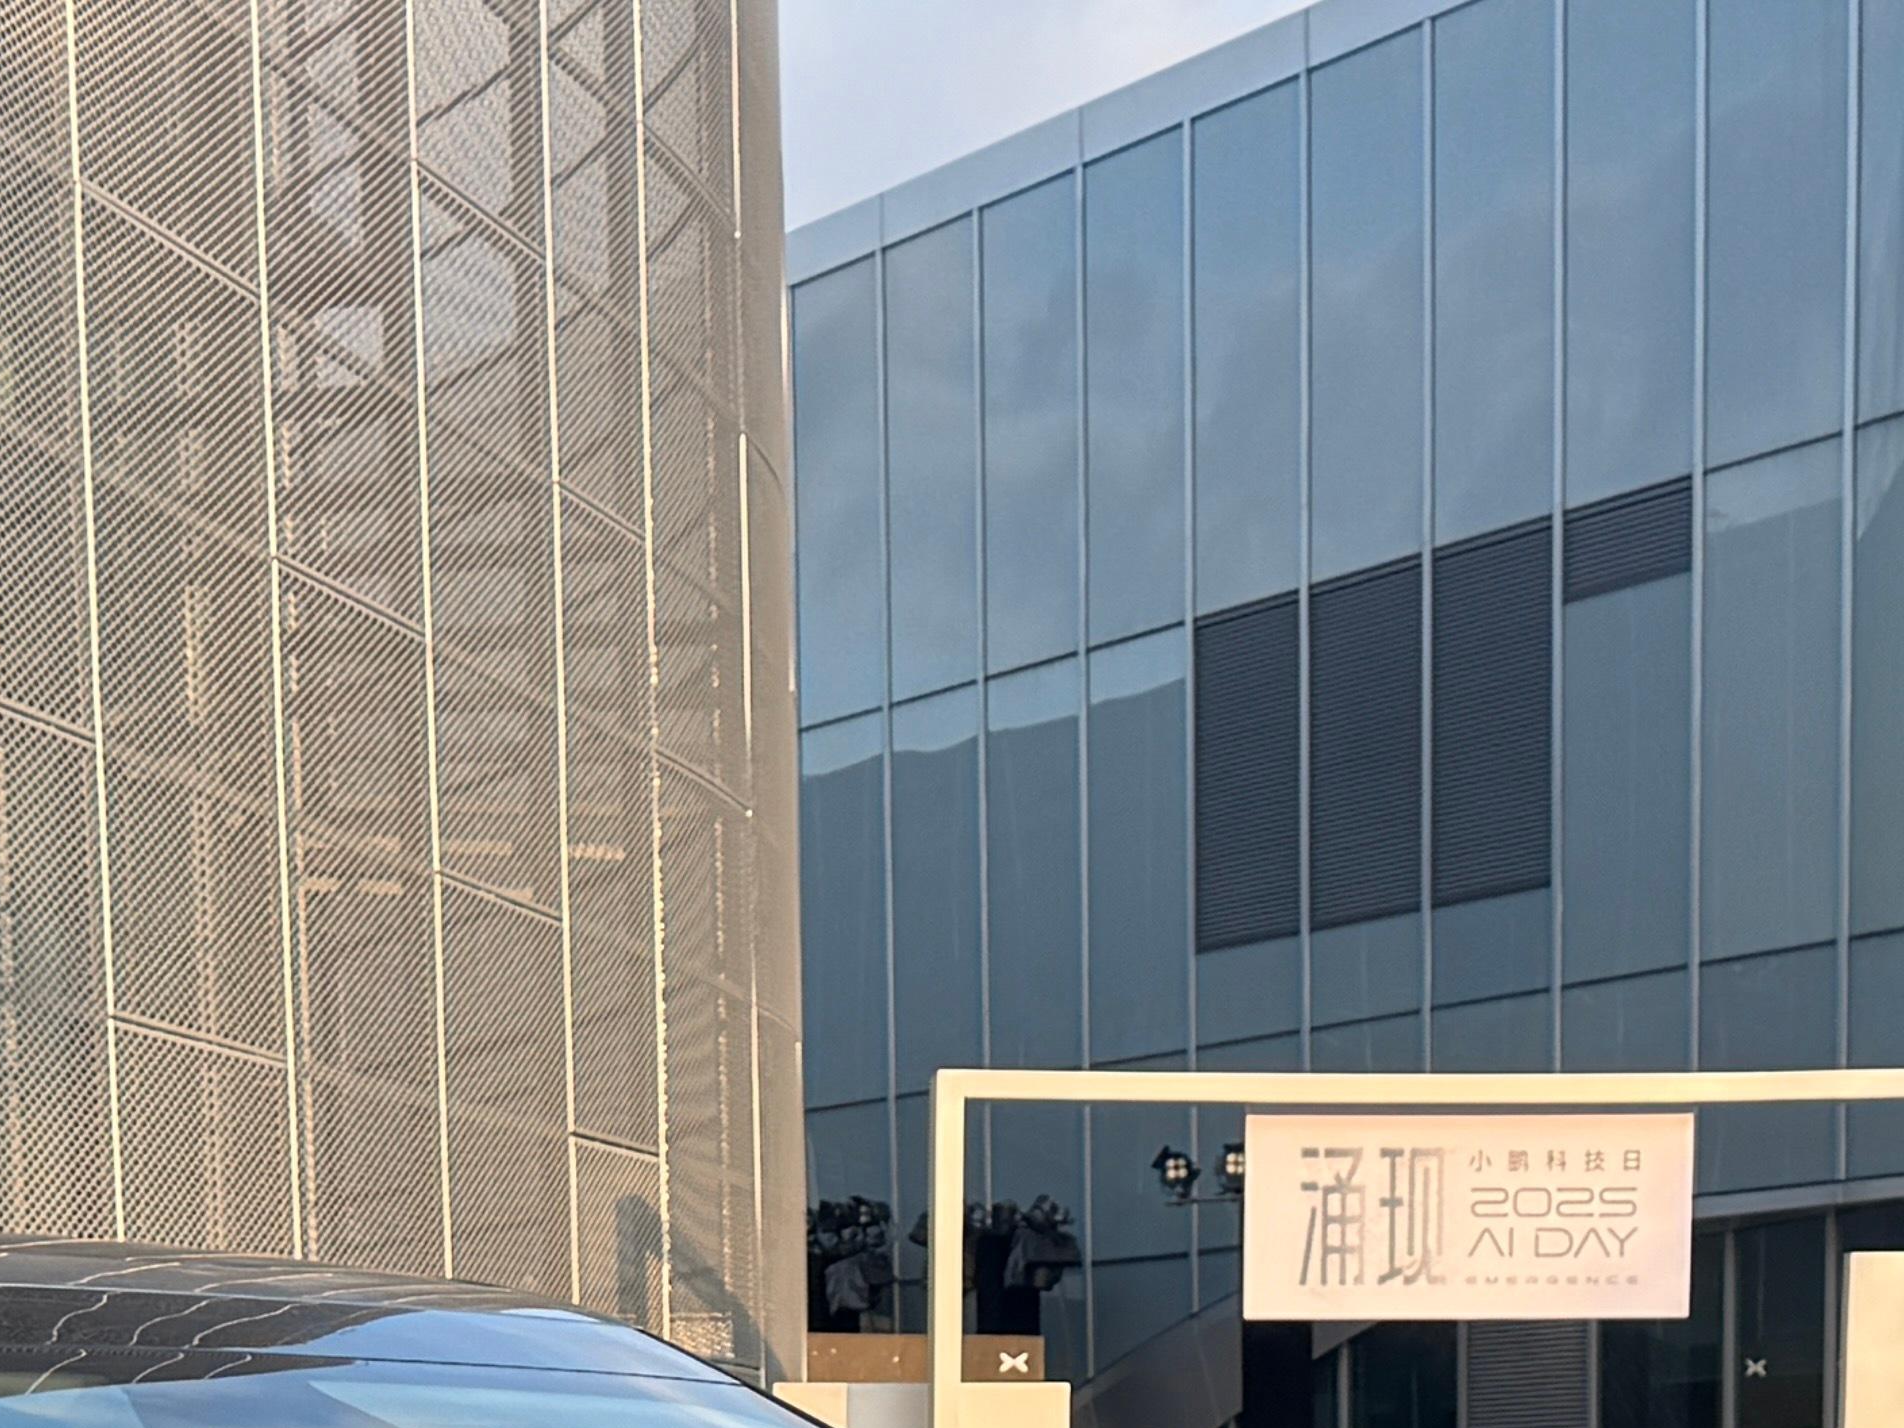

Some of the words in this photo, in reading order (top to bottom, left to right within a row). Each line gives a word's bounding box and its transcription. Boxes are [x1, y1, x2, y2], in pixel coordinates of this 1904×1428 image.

[1469, 1149, 1642, 1173] 小鹏科技日
[1299, 1146, 1447, 1286] 涌现
[1469, 1186, 1639, 1218] 2025
[1467, 1226, 1516, 1258] AI
[1534, 1226, 1639, 1258] DAY
